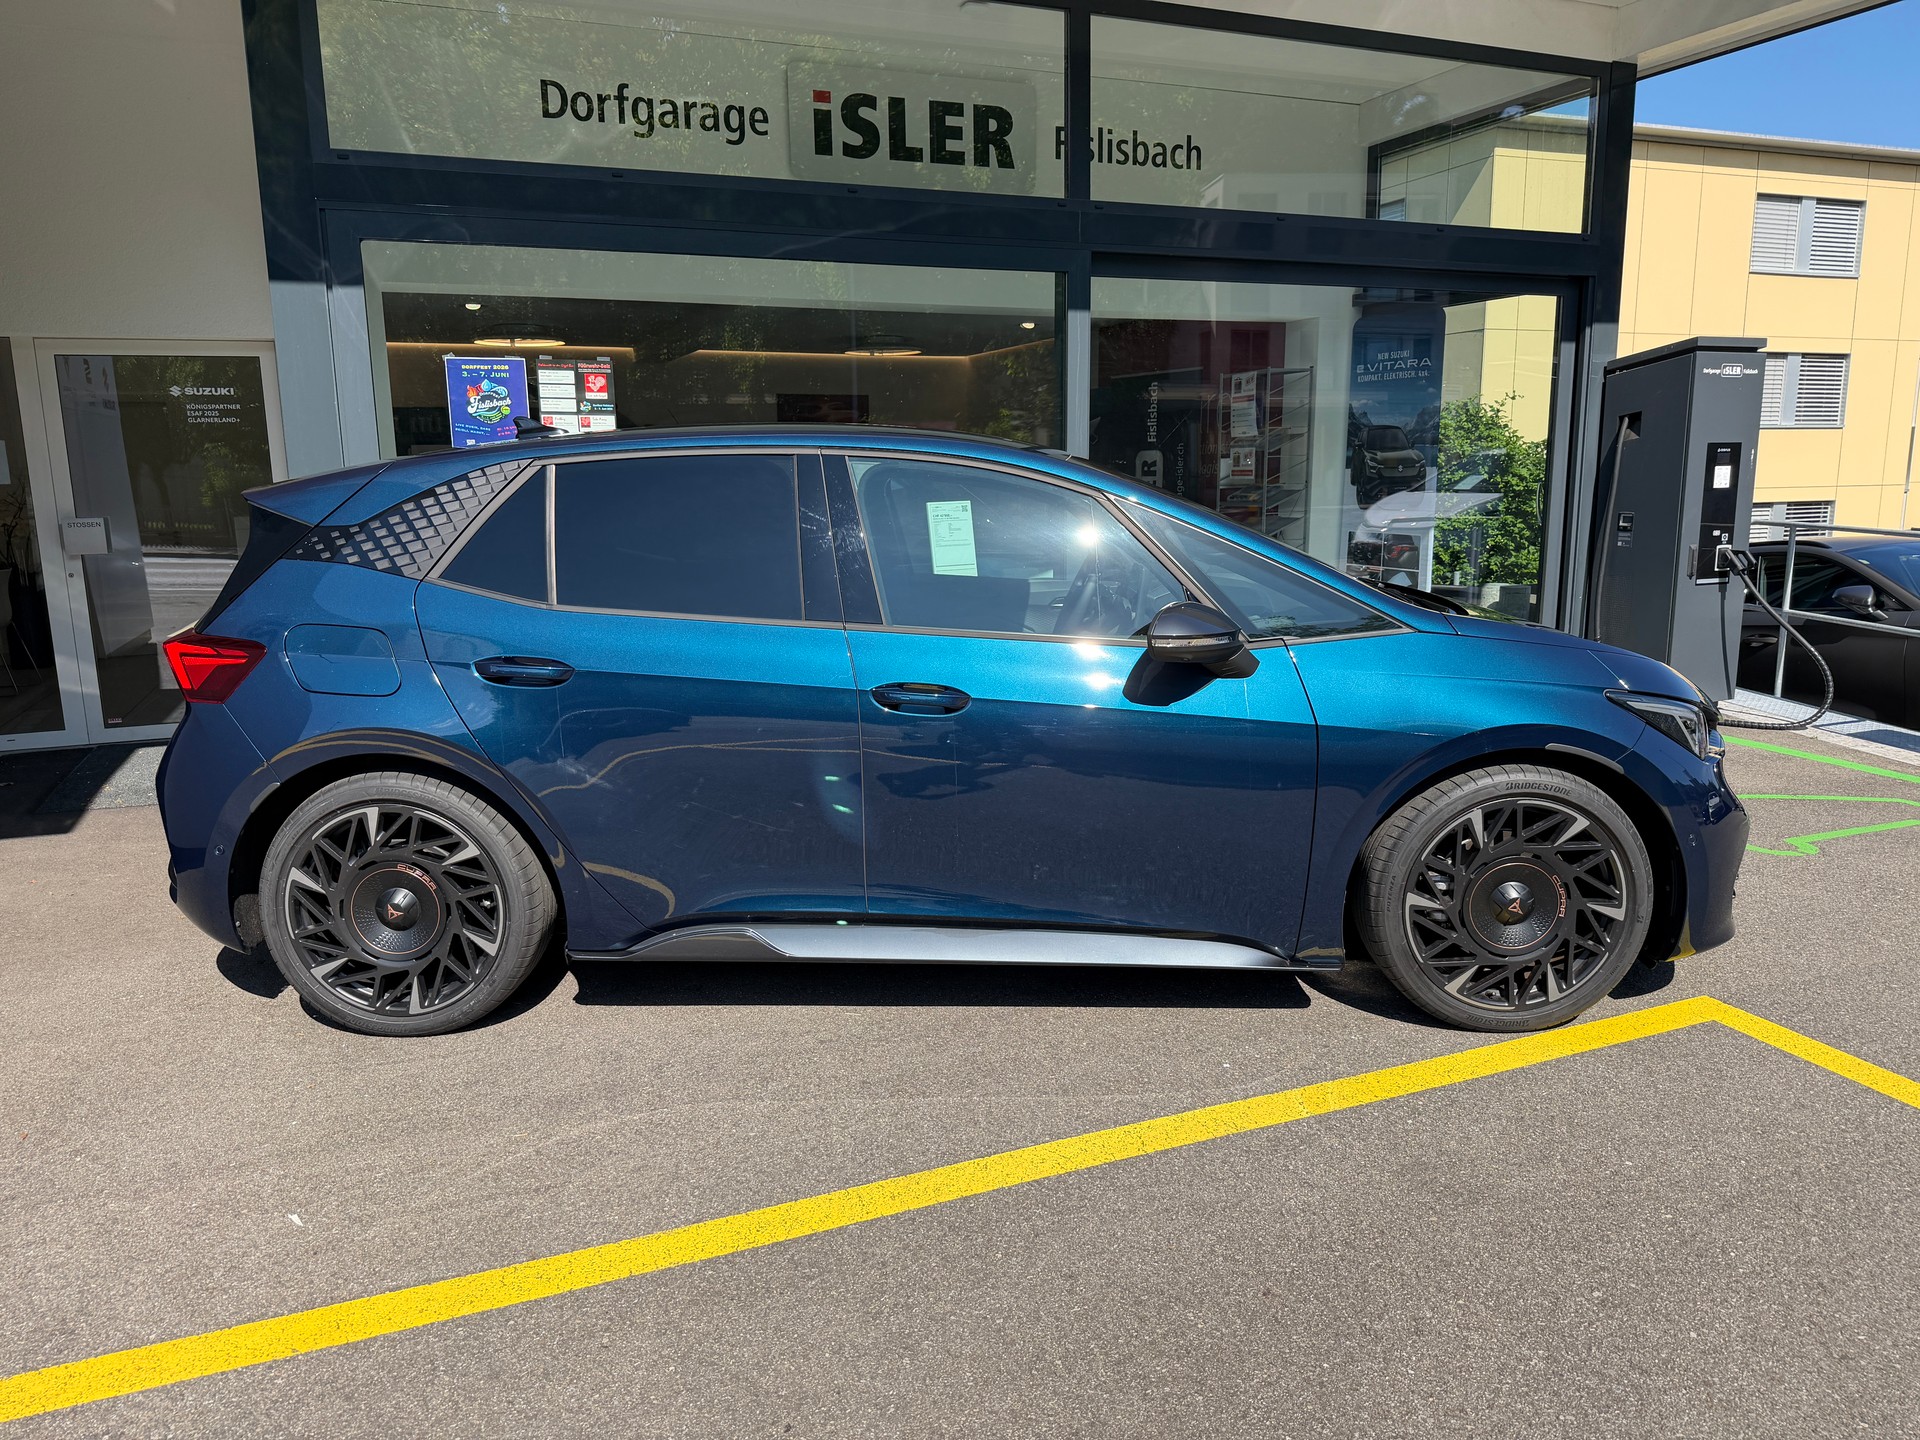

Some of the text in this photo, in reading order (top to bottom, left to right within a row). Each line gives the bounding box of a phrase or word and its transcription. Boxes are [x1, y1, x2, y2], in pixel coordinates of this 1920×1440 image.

[538, 77, 1202, 171] Dorfgarage iSLER Flisbach
[1377, 350, 1410, 361] NEW SUZUKI
[1367, 357, 1432, 372] VITARA
[1357, 374, 1383, 383] KOMPAKT.
[1384, 370, 1417, 381] ELEKTRISCH.
[184, 387, 234, 396] SUZUKI
[186, 402, 241, 410] KÖNIGSPARTNER
[467, 395, 512, 414] Fislisbach
[1147, 381, 1159, 443] Fislisbach
[1505, 782, 1573, 797] BRIDGESTONE
[1386, 875, 1397, 913] POTENZA
[1552, 874, 1567, 918] CUPRA
[1465, 1014, 1530, 1028] BRIDGESTONE
